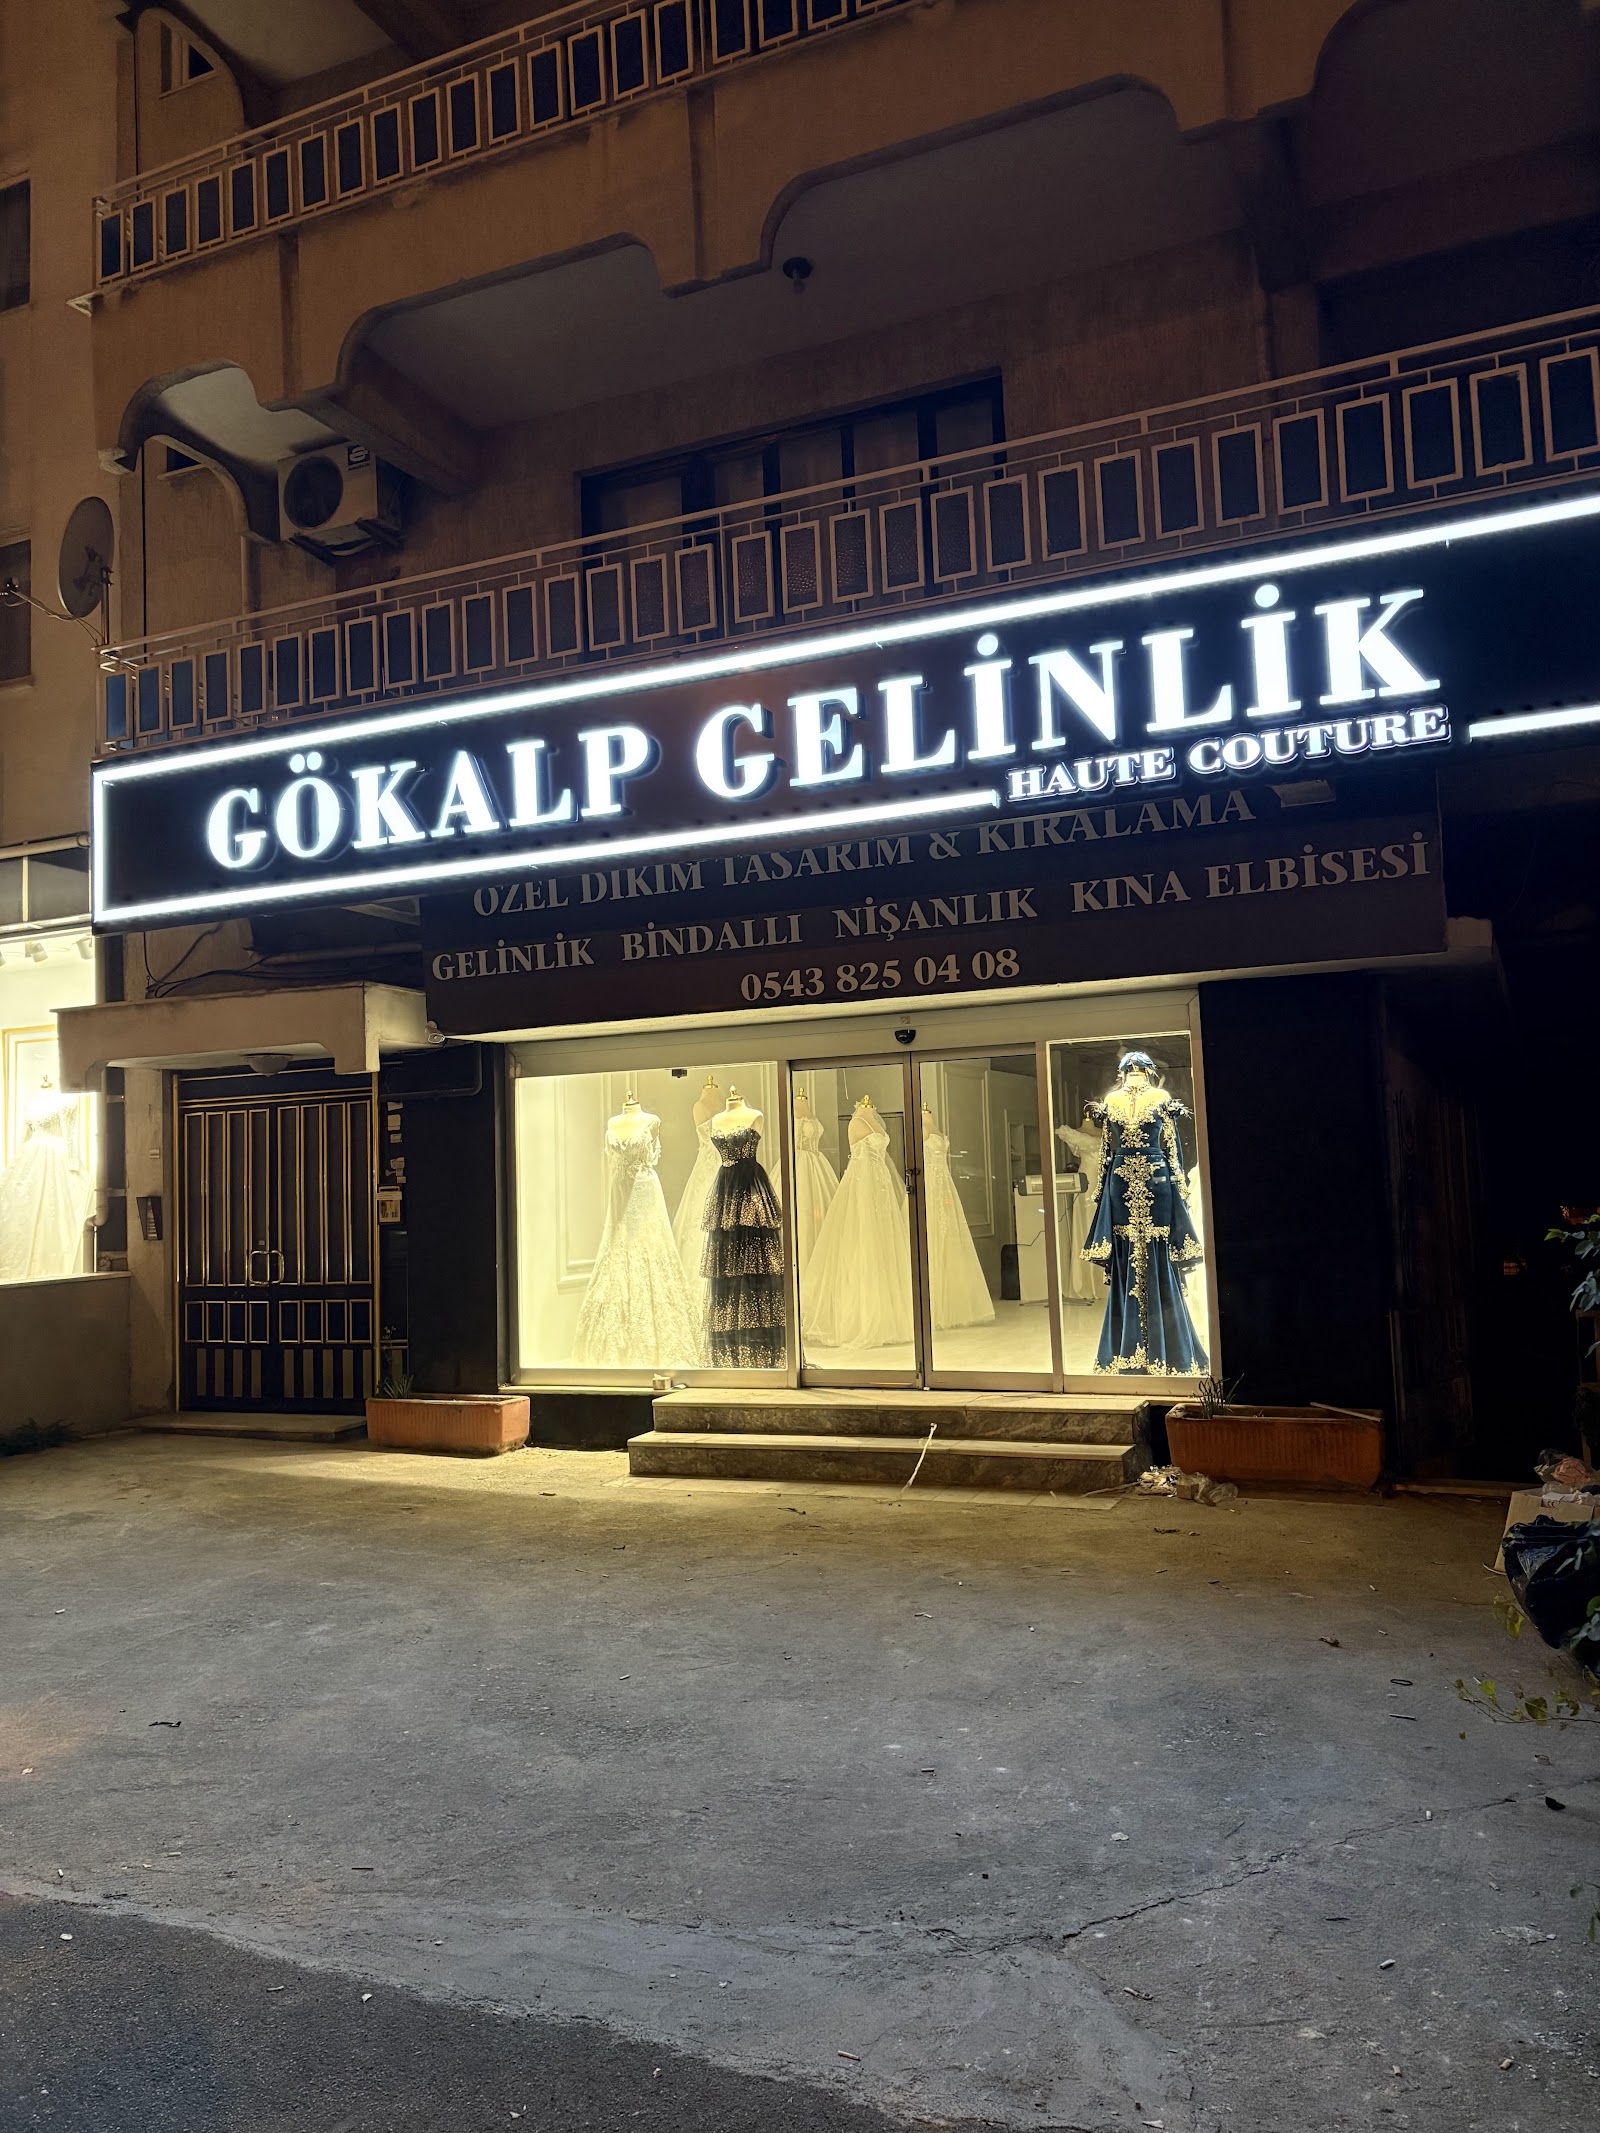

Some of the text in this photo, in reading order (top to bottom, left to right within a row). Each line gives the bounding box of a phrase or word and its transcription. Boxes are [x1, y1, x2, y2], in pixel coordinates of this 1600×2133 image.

[206, 584, 1441, 869] GÖKALP GELİNLİK
[1008, 706, 1450, 801] HAUTE COUTURE
[929, 831, 961, 860] &
[977, 789, 1256, 854] KIRALAMA
[432, 831, 1430, 981] GELİNLİK BİNDALLI NİŞANLIK KINA ELBİSESİ
[741, 948, 1020, 1001] 0543 825 04 08
